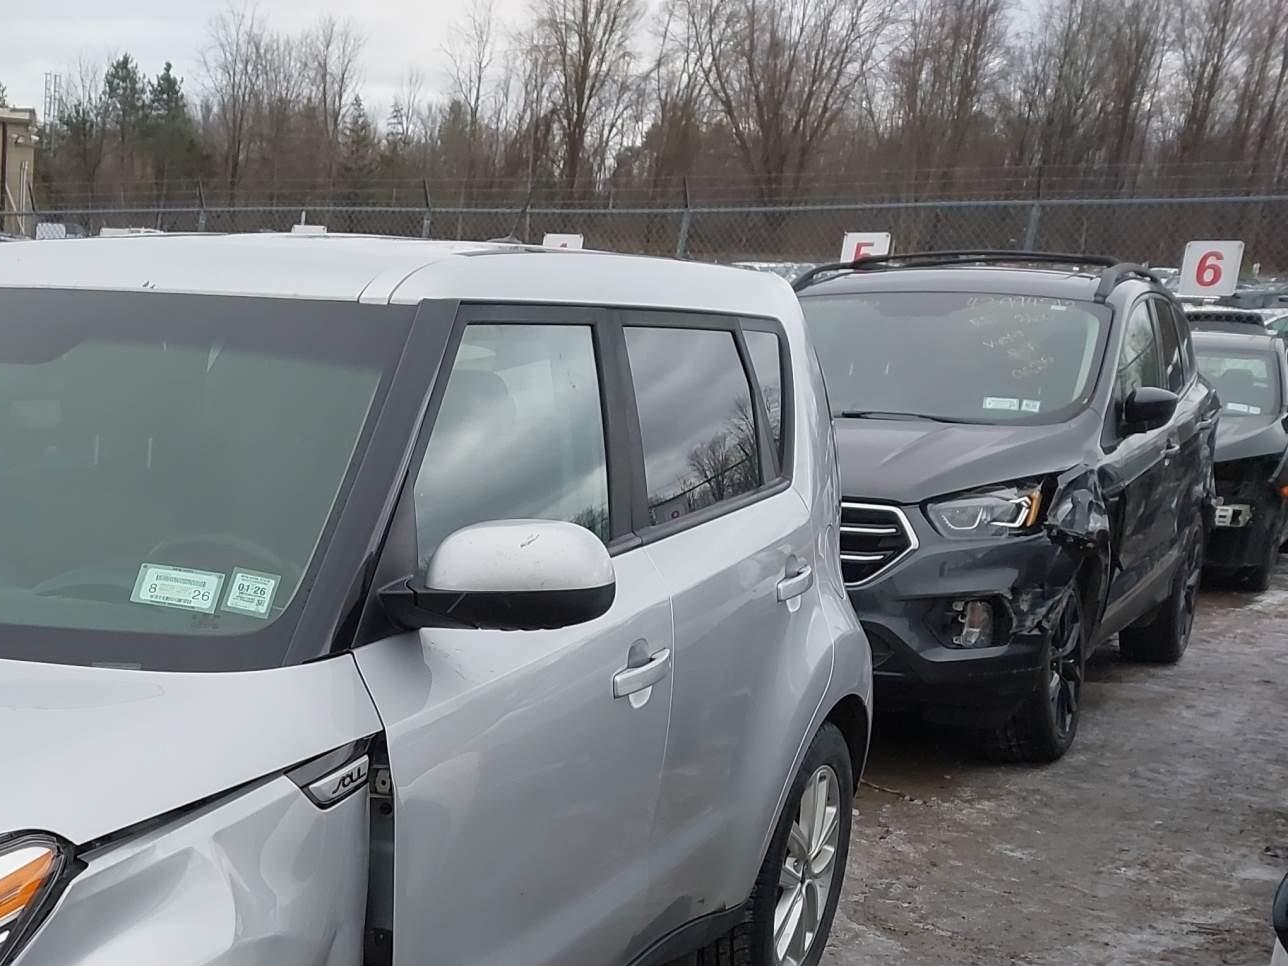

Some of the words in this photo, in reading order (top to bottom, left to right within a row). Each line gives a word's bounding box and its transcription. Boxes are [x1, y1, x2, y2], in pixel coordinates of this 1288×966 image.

[1195, 250, 1225, 287] 6
[148, 583, 158, 594] 8
[191, 589, 211, 602] 26
